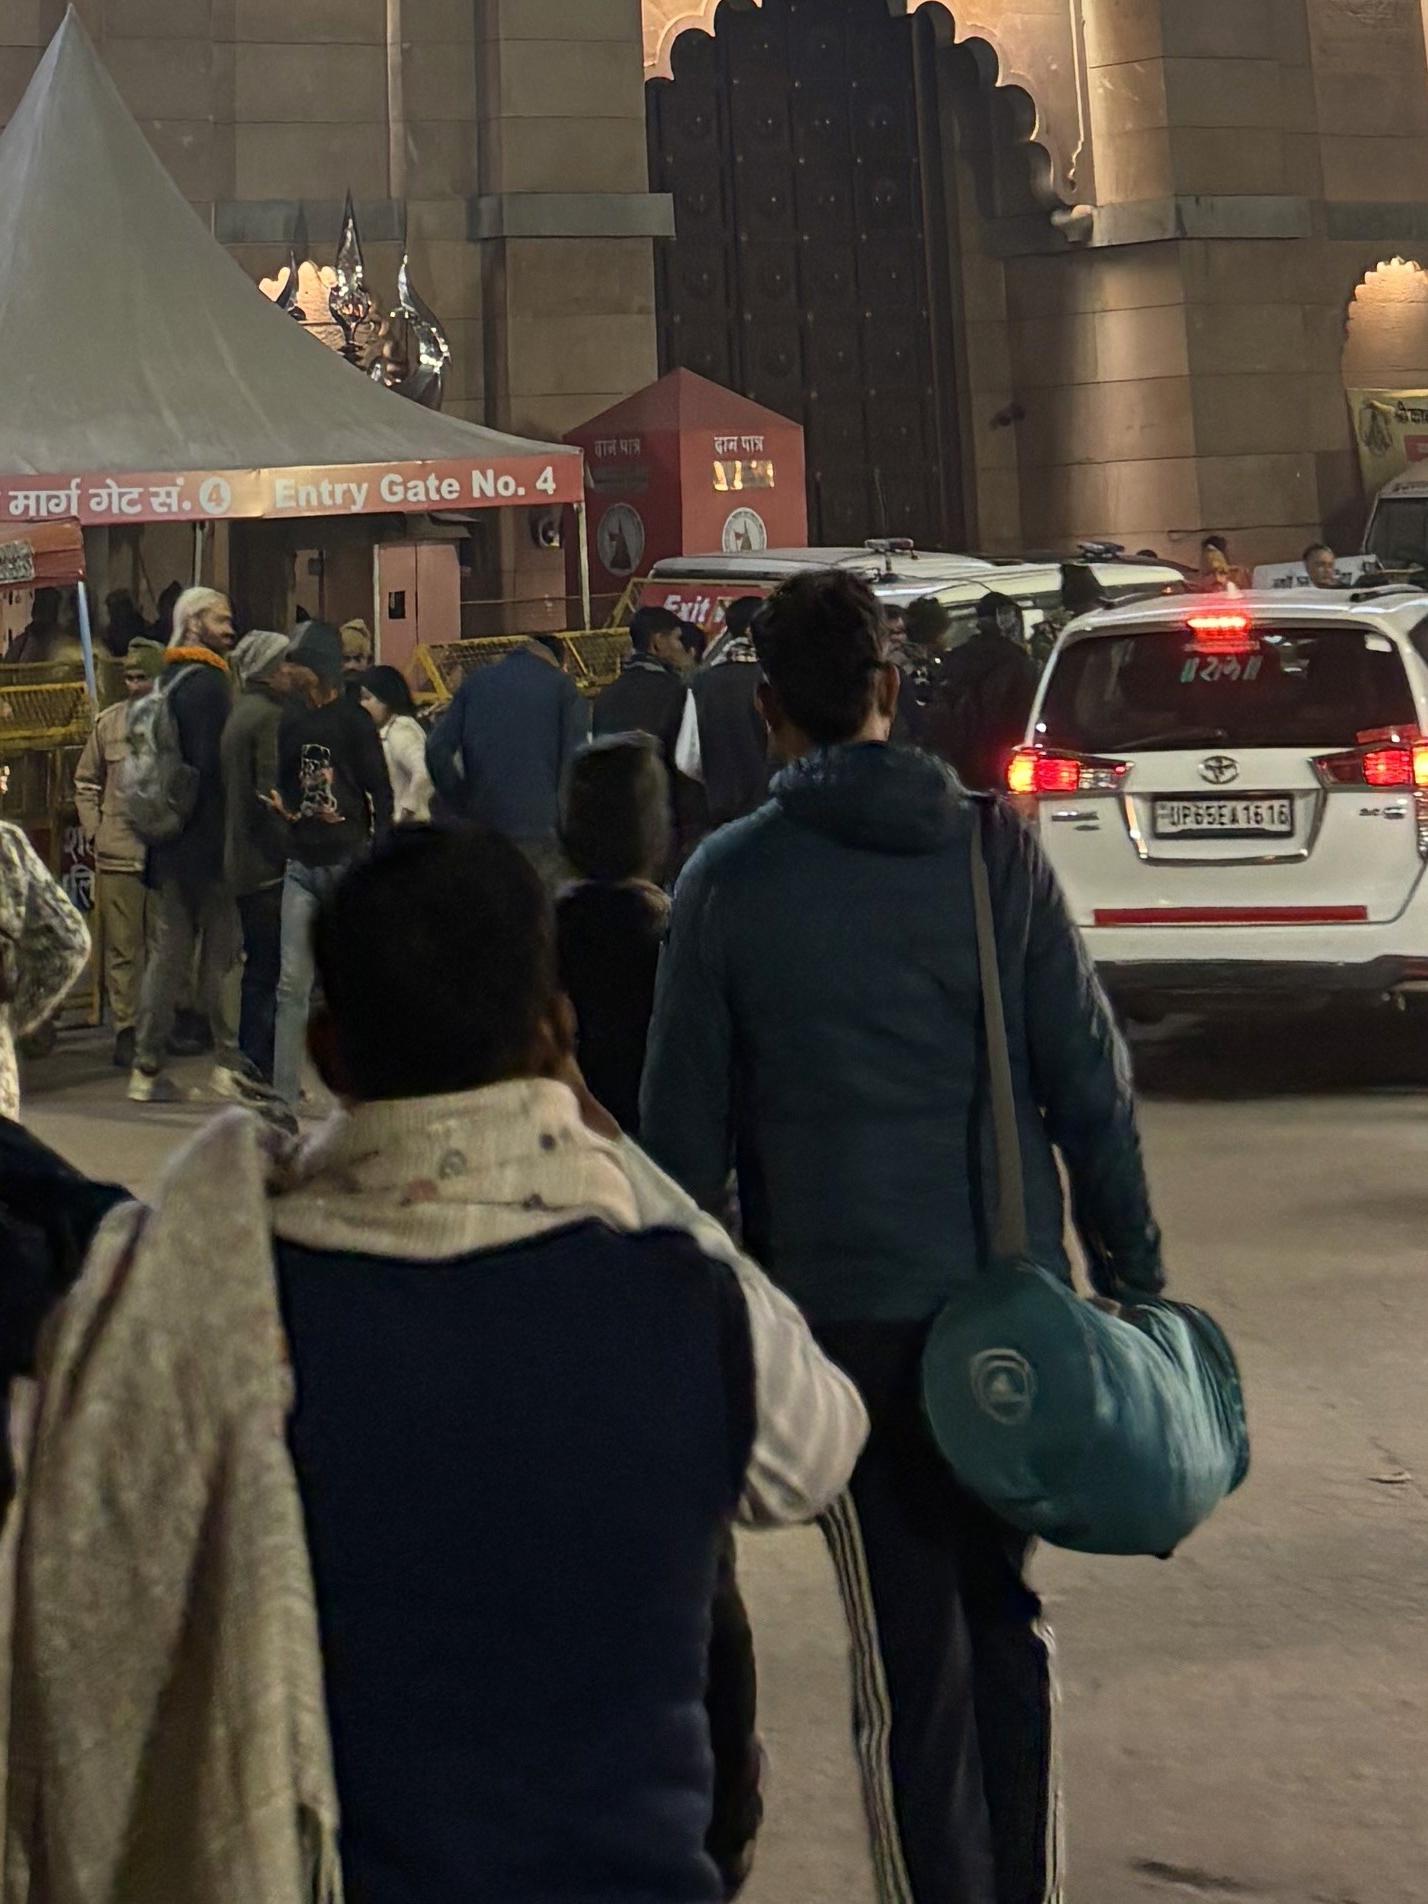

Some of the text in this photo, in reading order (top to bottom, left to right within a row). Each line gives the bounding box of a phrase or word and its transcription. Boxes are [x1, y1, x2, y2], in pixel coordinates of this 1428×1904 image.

[713, 435, 765, 455] दान पात्र
[8, 478, 81, 516] मार्ग
[88, 478, 144, 514] गेट
[149, 477, 191, 513] सं.
[275, 466, 556, 512] Entry Gate No. 4
[663, 594, 712, 623] Exit
